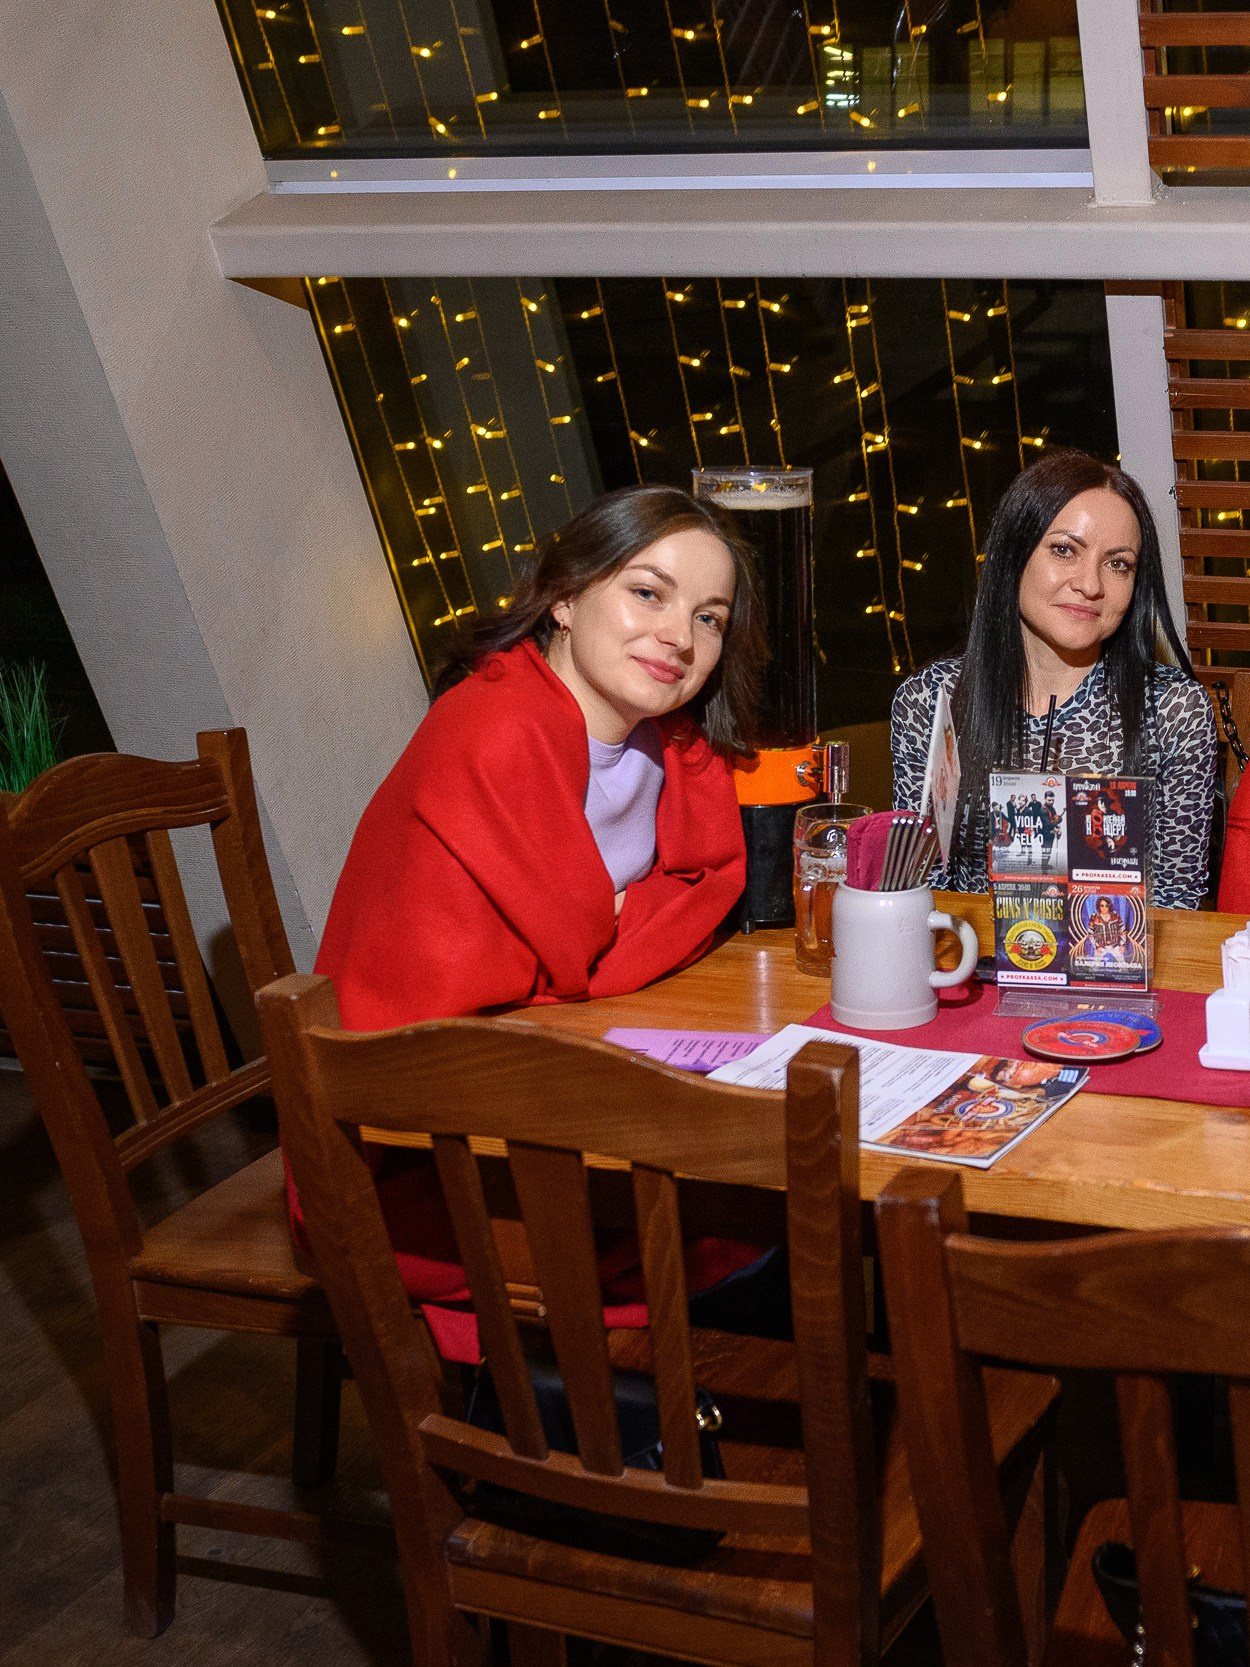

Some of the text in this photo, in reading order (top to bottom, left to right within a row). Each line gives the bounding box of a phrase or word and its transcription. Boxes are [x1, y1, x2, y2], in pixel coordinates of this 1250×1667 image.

[991, 776, 1002, 787] 19
[1014, 815, 1043, 829] VIOLA
[1072, 884, 1083, 893] 26
[996, 896, 1021, 919] GUNS
[1033, 898, 1064, 921] ROSES
